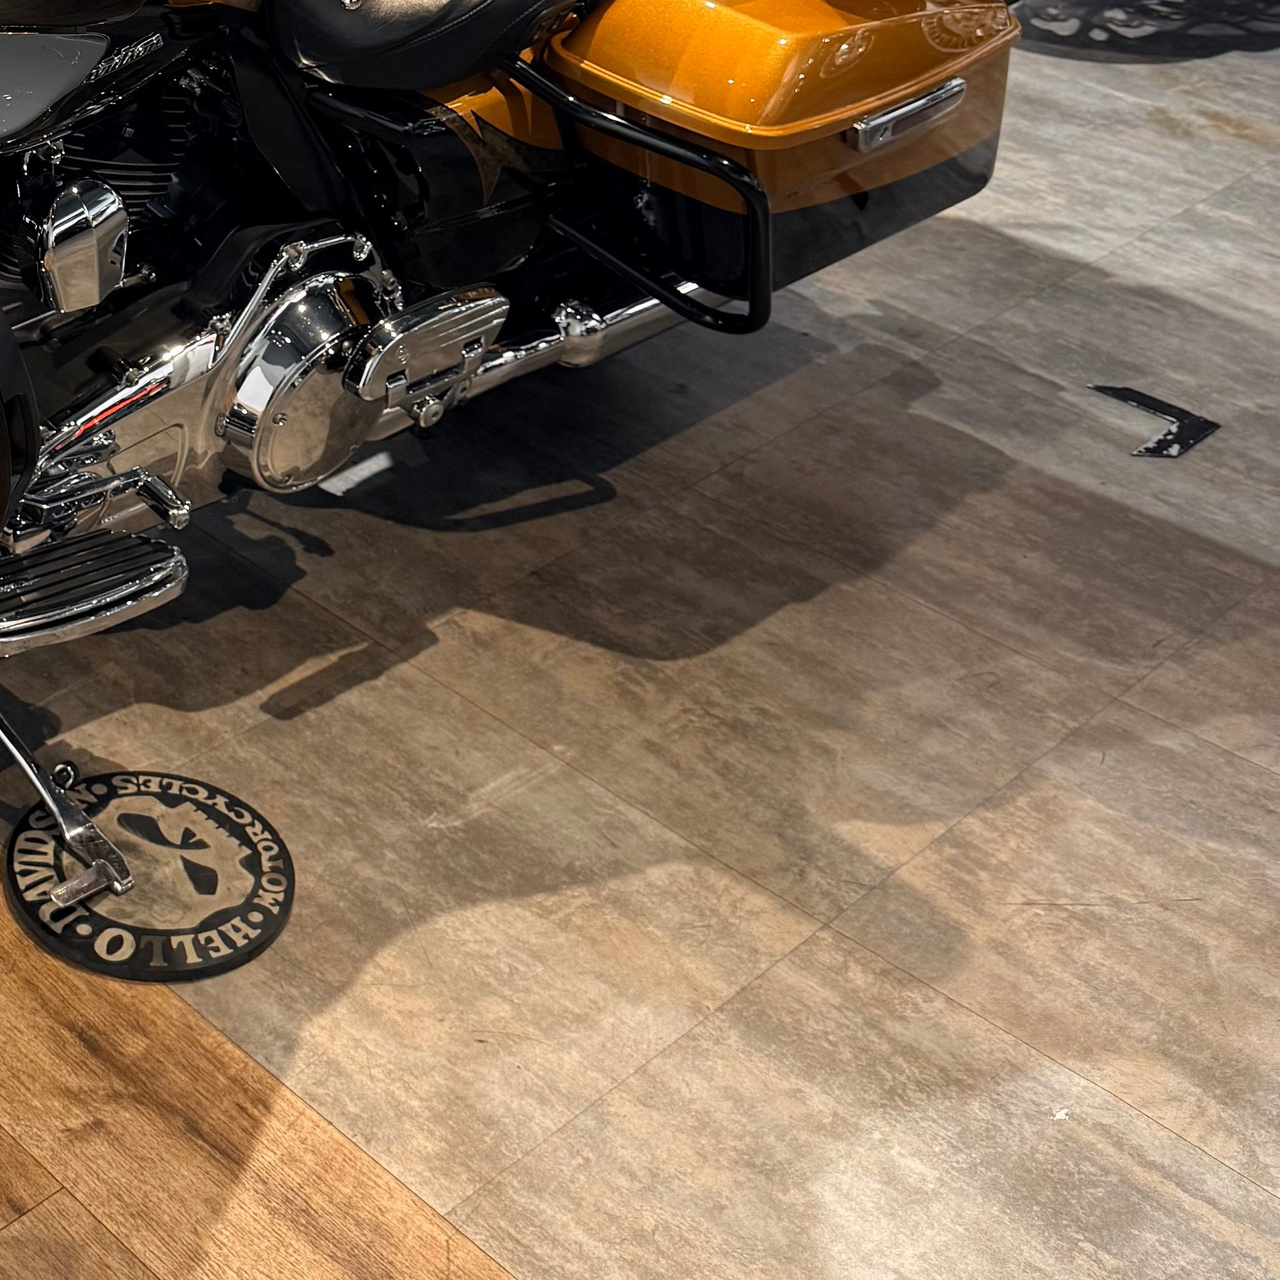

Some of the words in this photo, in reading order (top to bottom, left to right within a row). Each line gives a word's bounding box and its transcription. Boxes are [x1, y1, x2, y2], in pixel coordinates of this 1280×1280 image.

[13, 783, 99, 934] DAVIDSN
[111, 775, 288, 915] MOTORCYCLES
[93, 915, 262, 967] HELLO
